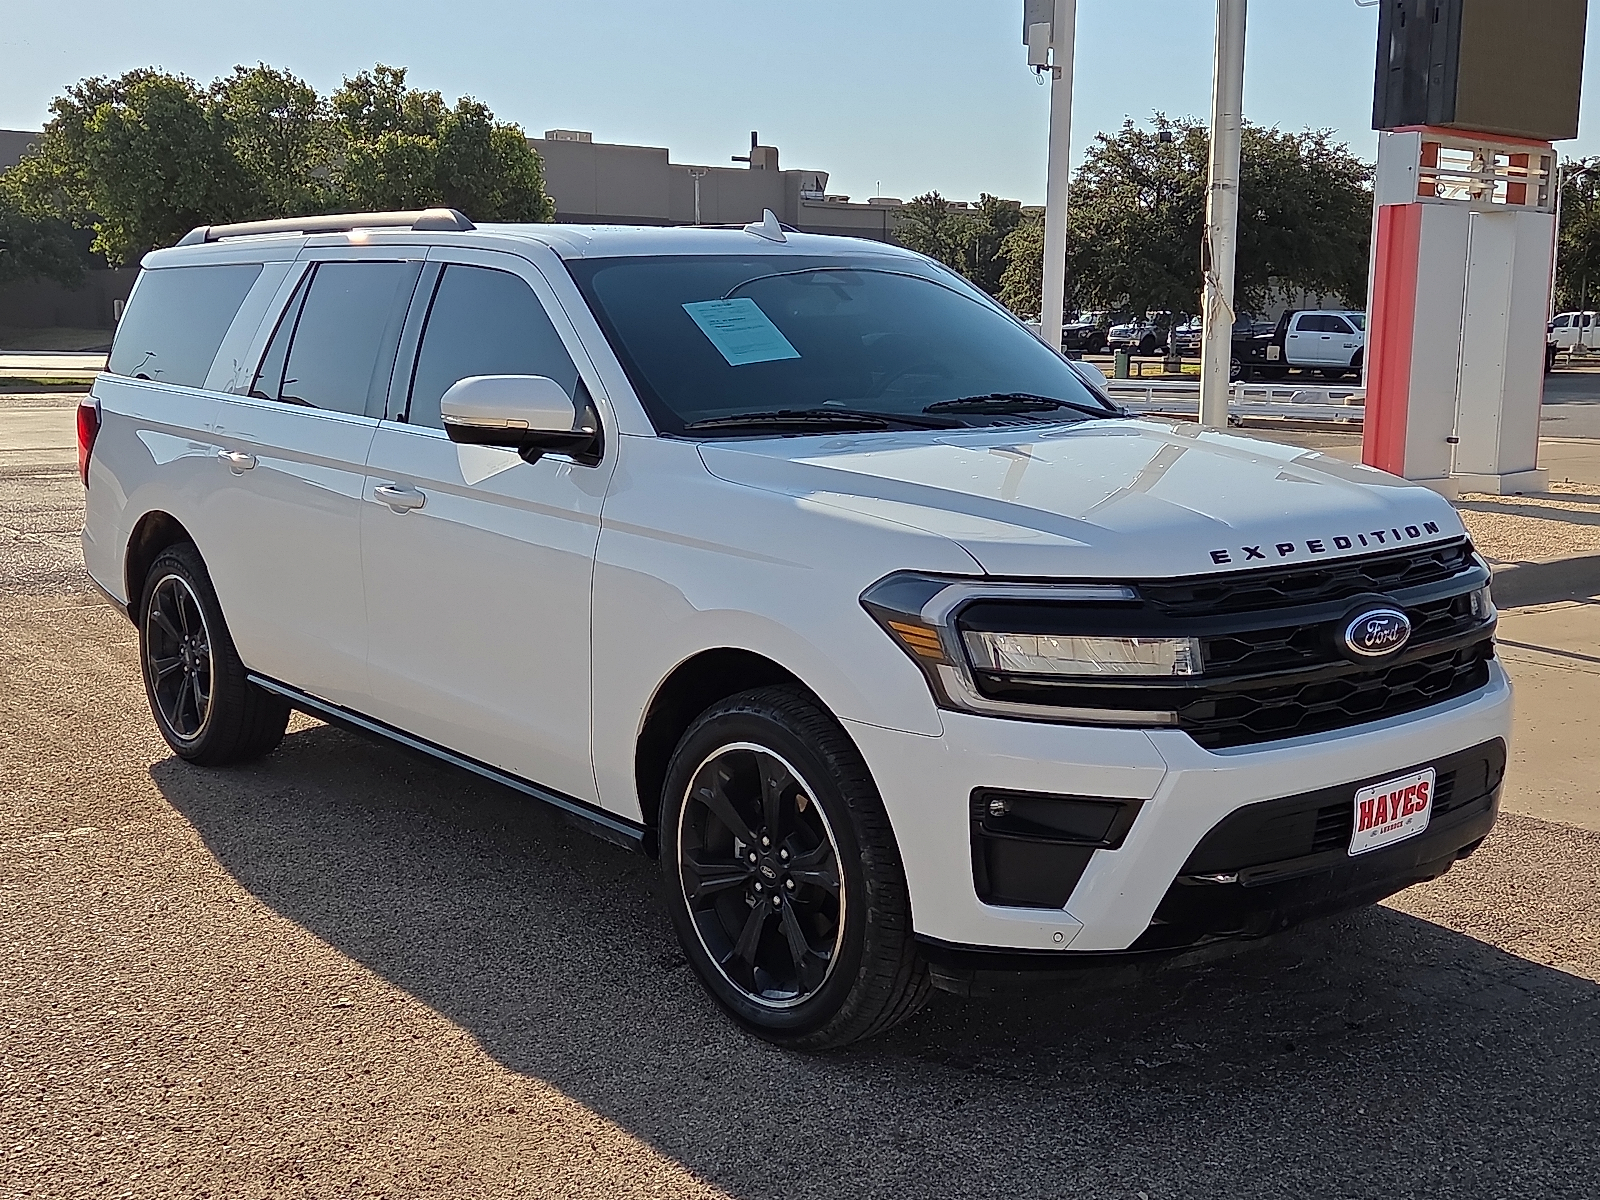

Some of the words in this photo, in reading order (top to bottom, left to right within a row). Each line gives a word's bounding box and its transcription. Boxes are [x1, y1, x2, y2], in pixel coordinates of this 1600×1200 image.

[1209, 521, 1440, 564] EXPEDITION
[1365, 620, 1399, 647] Ford
[1358, 781, 1429, 832] HAYES
